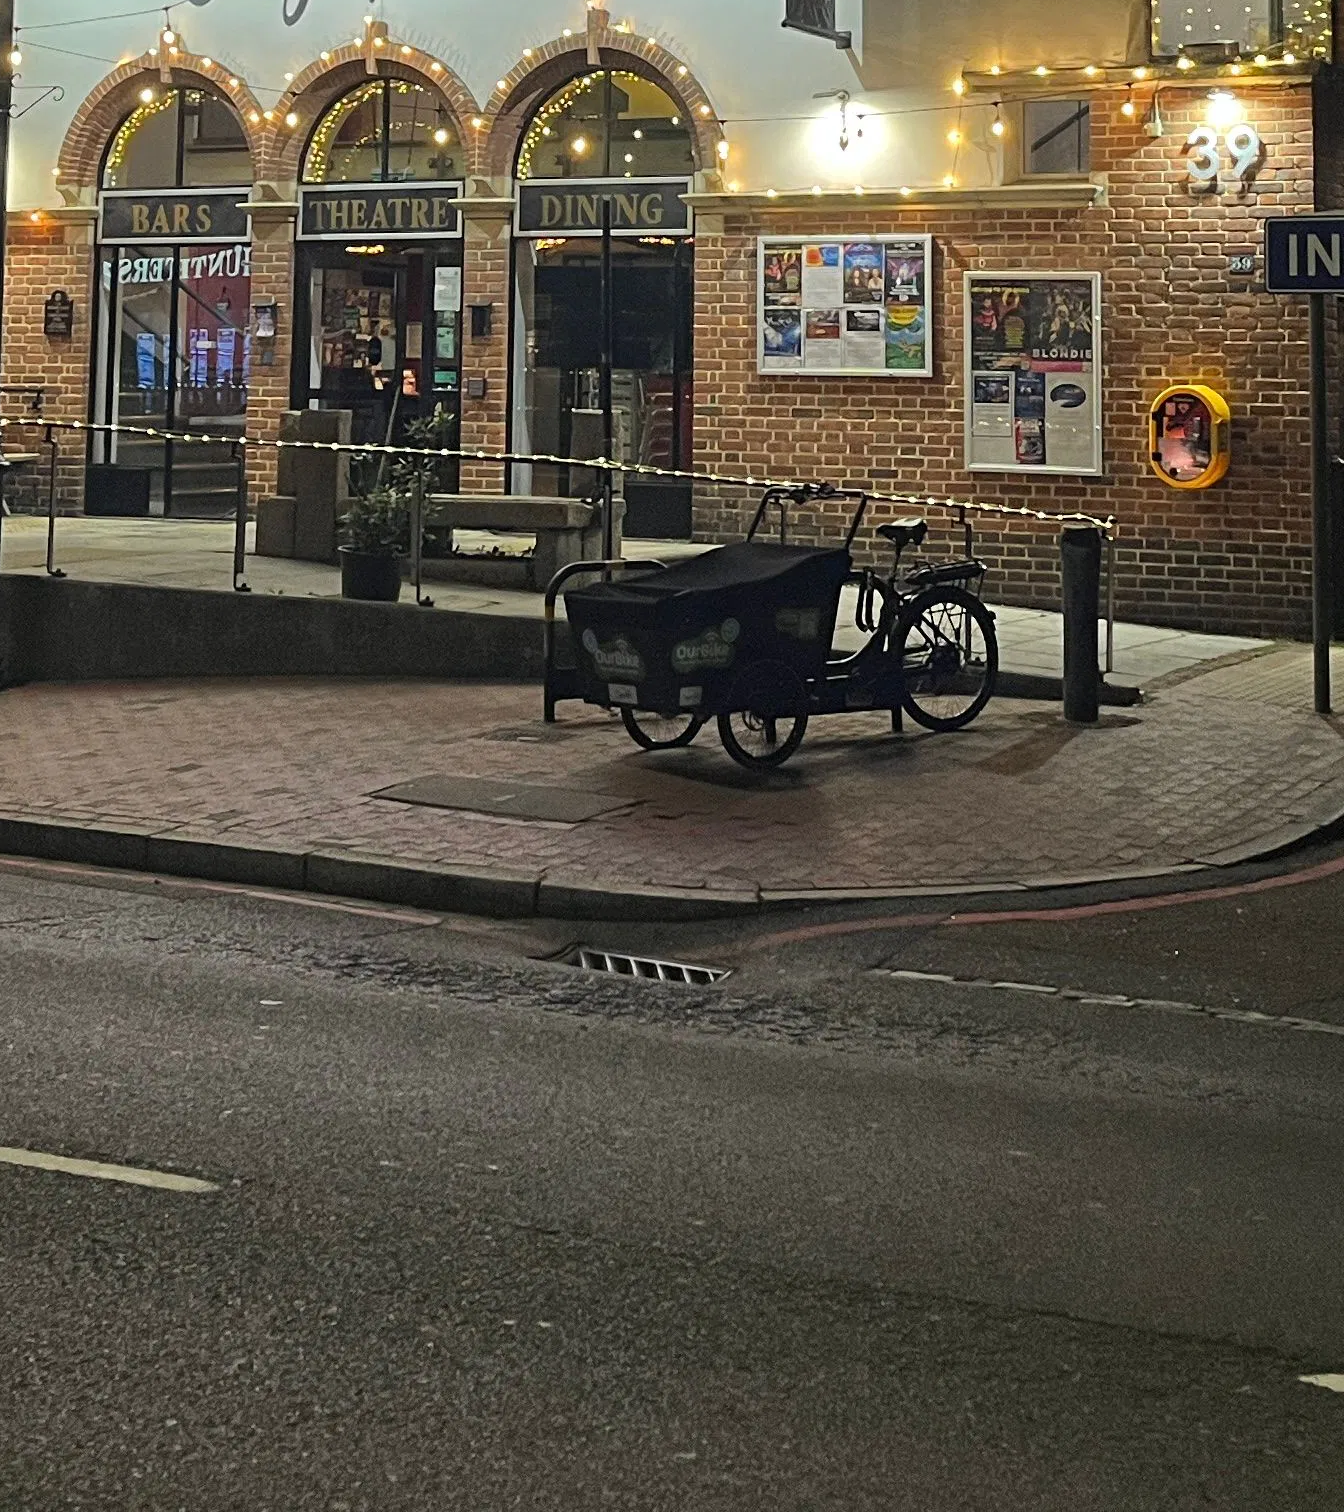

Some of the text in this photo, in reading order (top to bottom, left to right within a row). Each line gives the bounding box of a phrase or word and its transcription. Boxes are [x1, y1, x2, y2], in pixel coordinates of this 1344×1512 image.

[1186, 123, 1261, 182] 39
[131, 203, 213, 235] BARS
[309, 195, 451, 234] THEATRE
[539, 193, 665, 227] DINNG
[1231, 256, 1252, 271] 39
[1288, 232, 1342, 278] IN
[1031, 347, 1093, 360] BLONDIE
